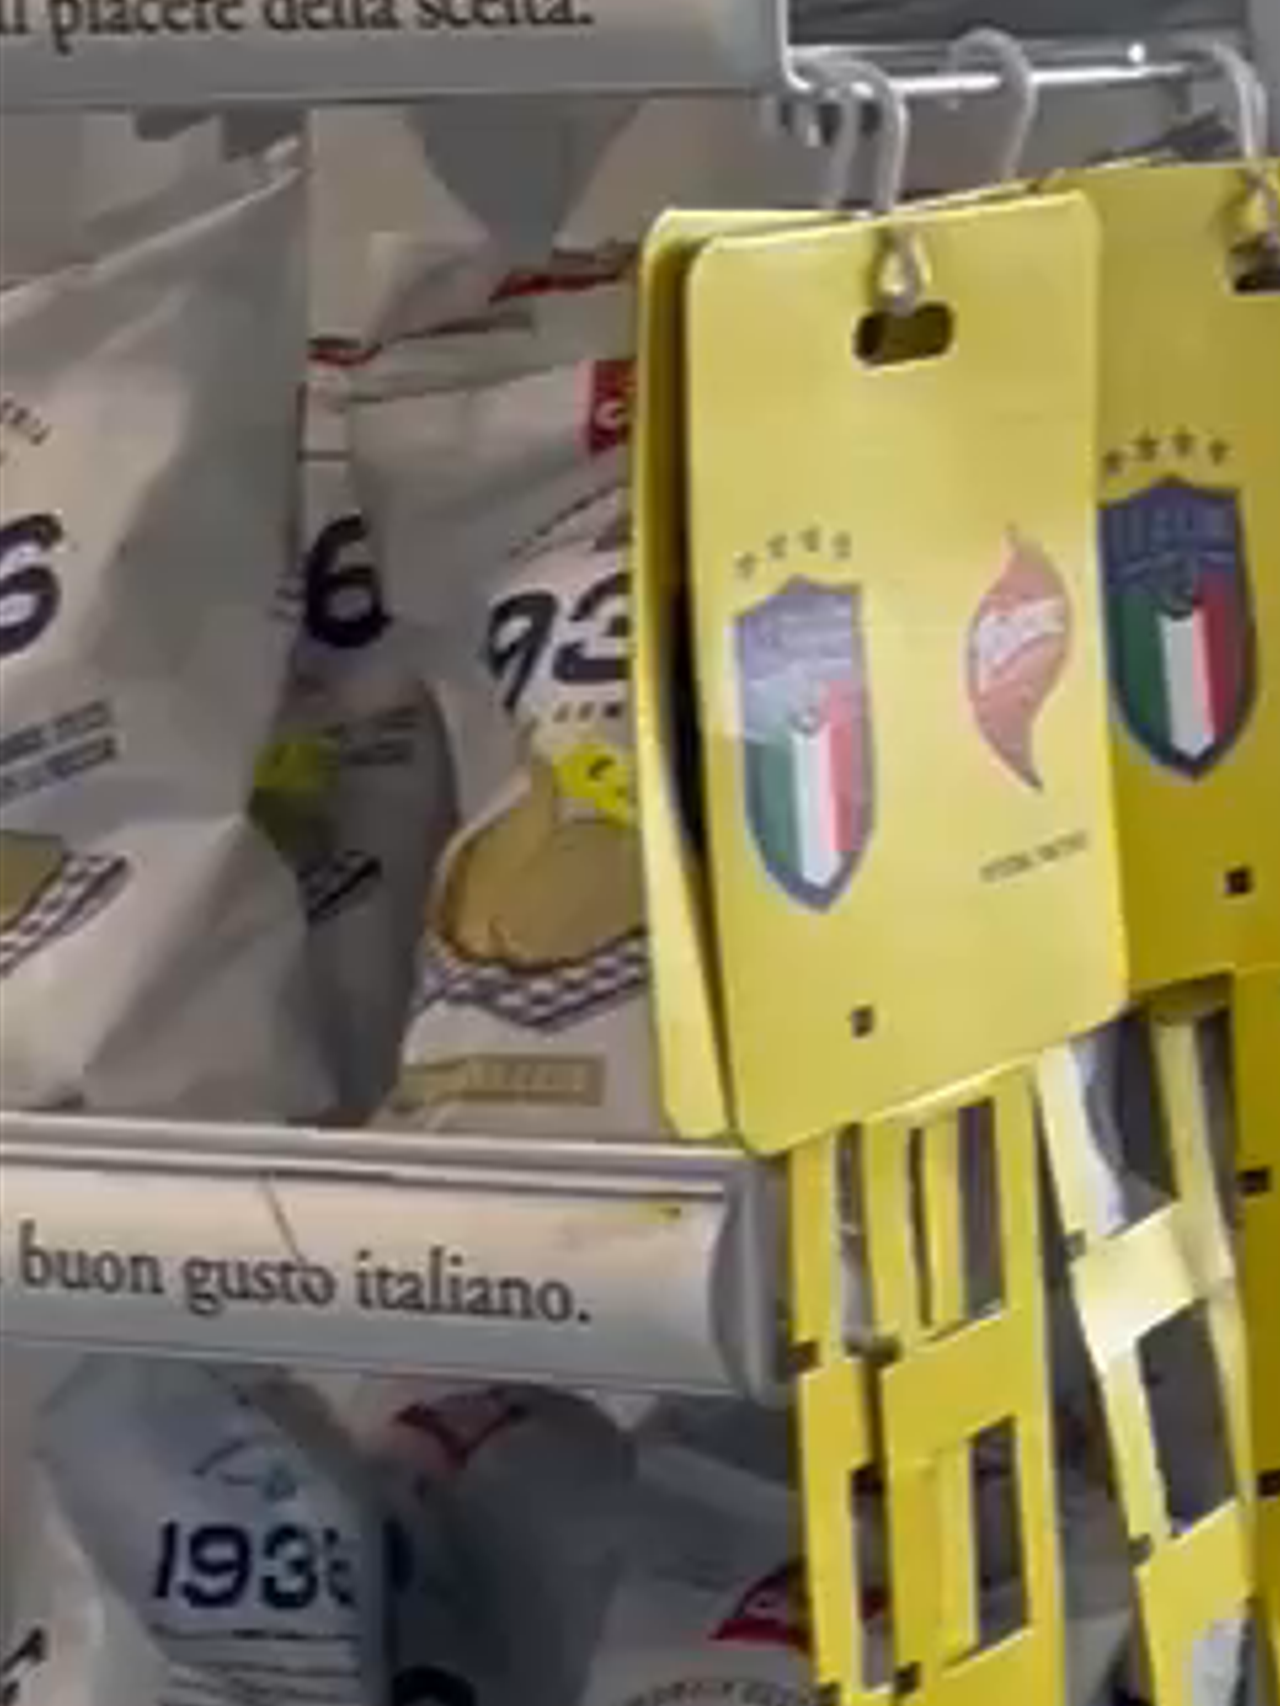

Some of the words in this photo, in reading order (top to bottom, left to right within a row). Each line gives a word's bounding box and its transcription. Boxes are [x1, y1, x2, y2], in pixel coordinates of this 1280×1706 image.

[20, 1220, 165, 1296] buon
[182, 1250, 336, 1317] gusto
[355, 1247, 592, 1325] italiano.
